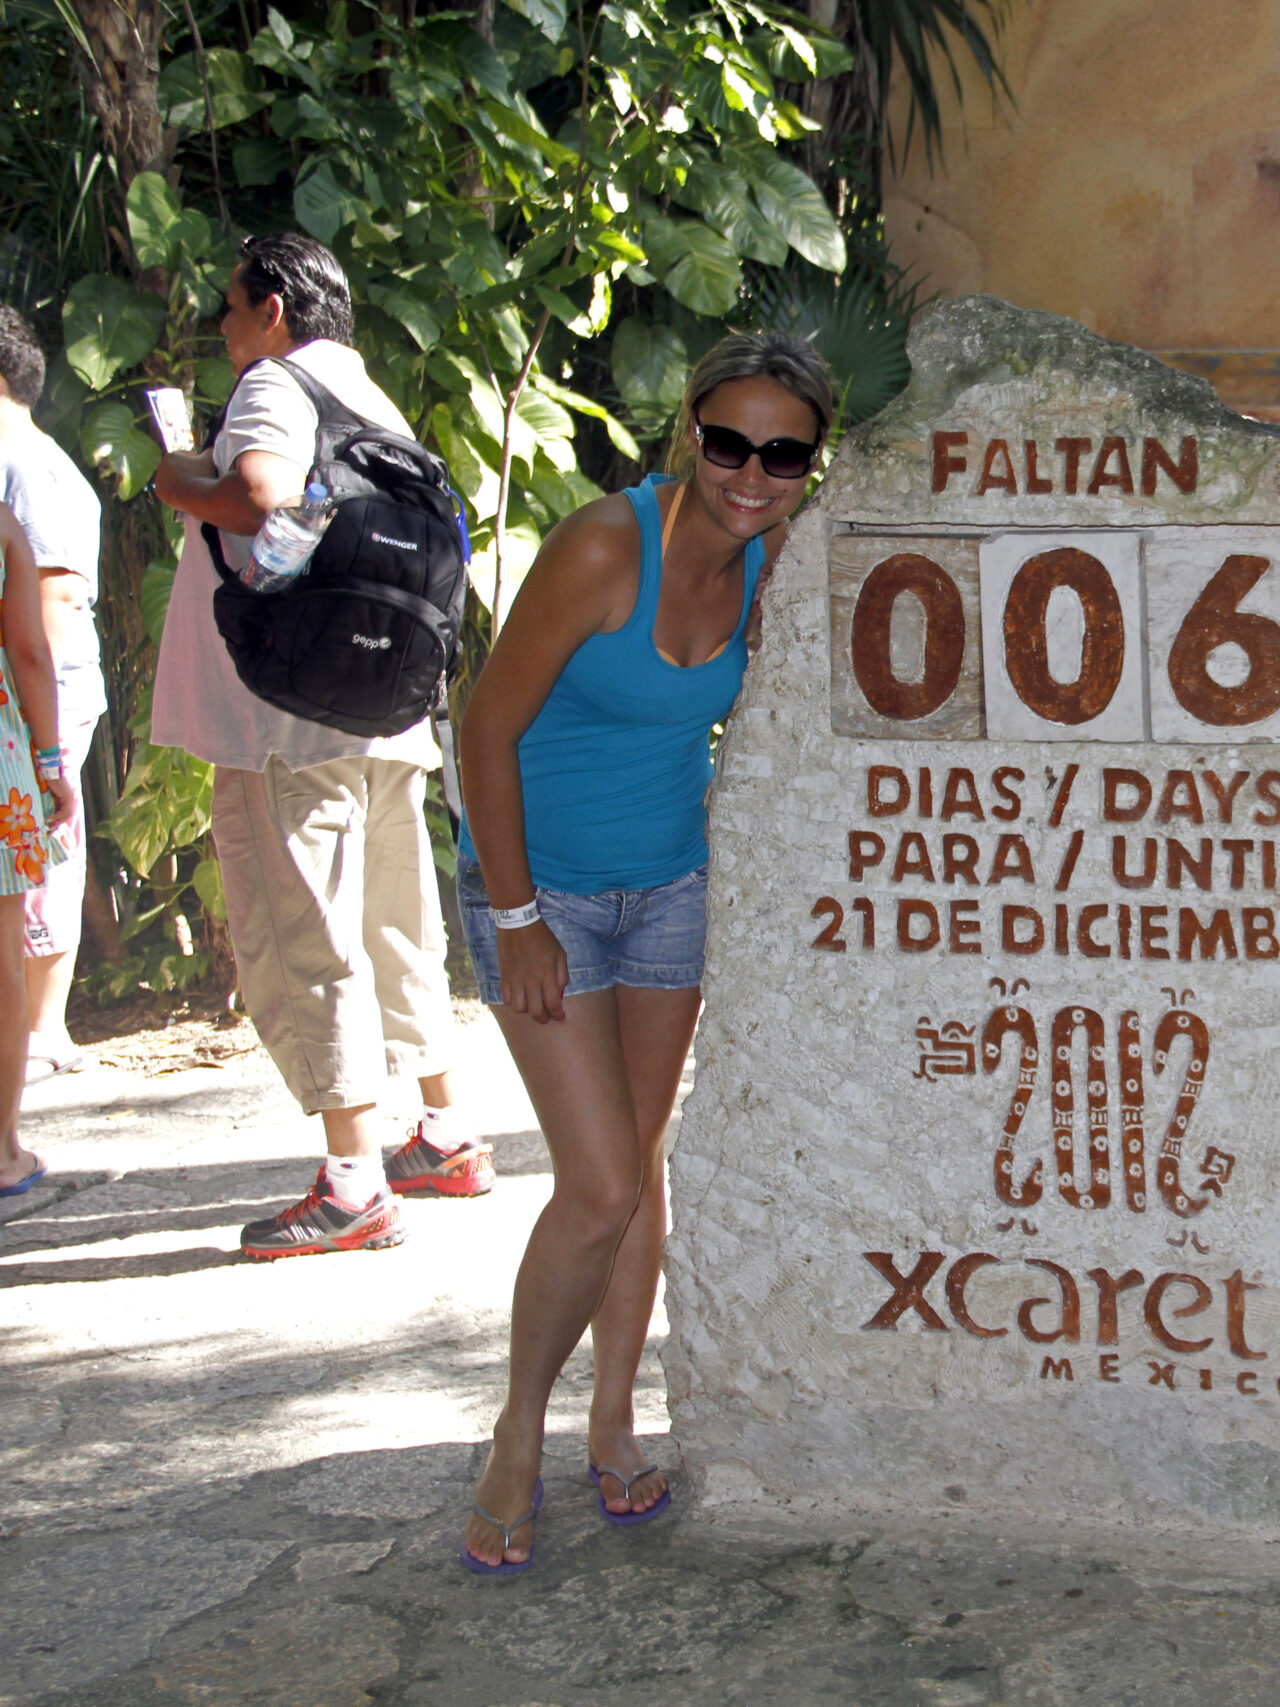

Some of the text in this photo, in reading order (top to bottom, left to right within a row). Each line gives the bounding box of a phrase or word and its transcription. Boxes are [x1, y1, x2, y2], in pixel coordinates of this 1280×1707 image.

[931, 430, 1199, 497] FALTAN
[380, 536, 418, 551] WENGER
[866, 763, 1026, 824] DIAS
[848, 829, 1036, 885] PARA
[810, 896, 876, 953] 21
[898, 898, 983, 955] DE
[980, 1004, 1212, 1218] 2012
